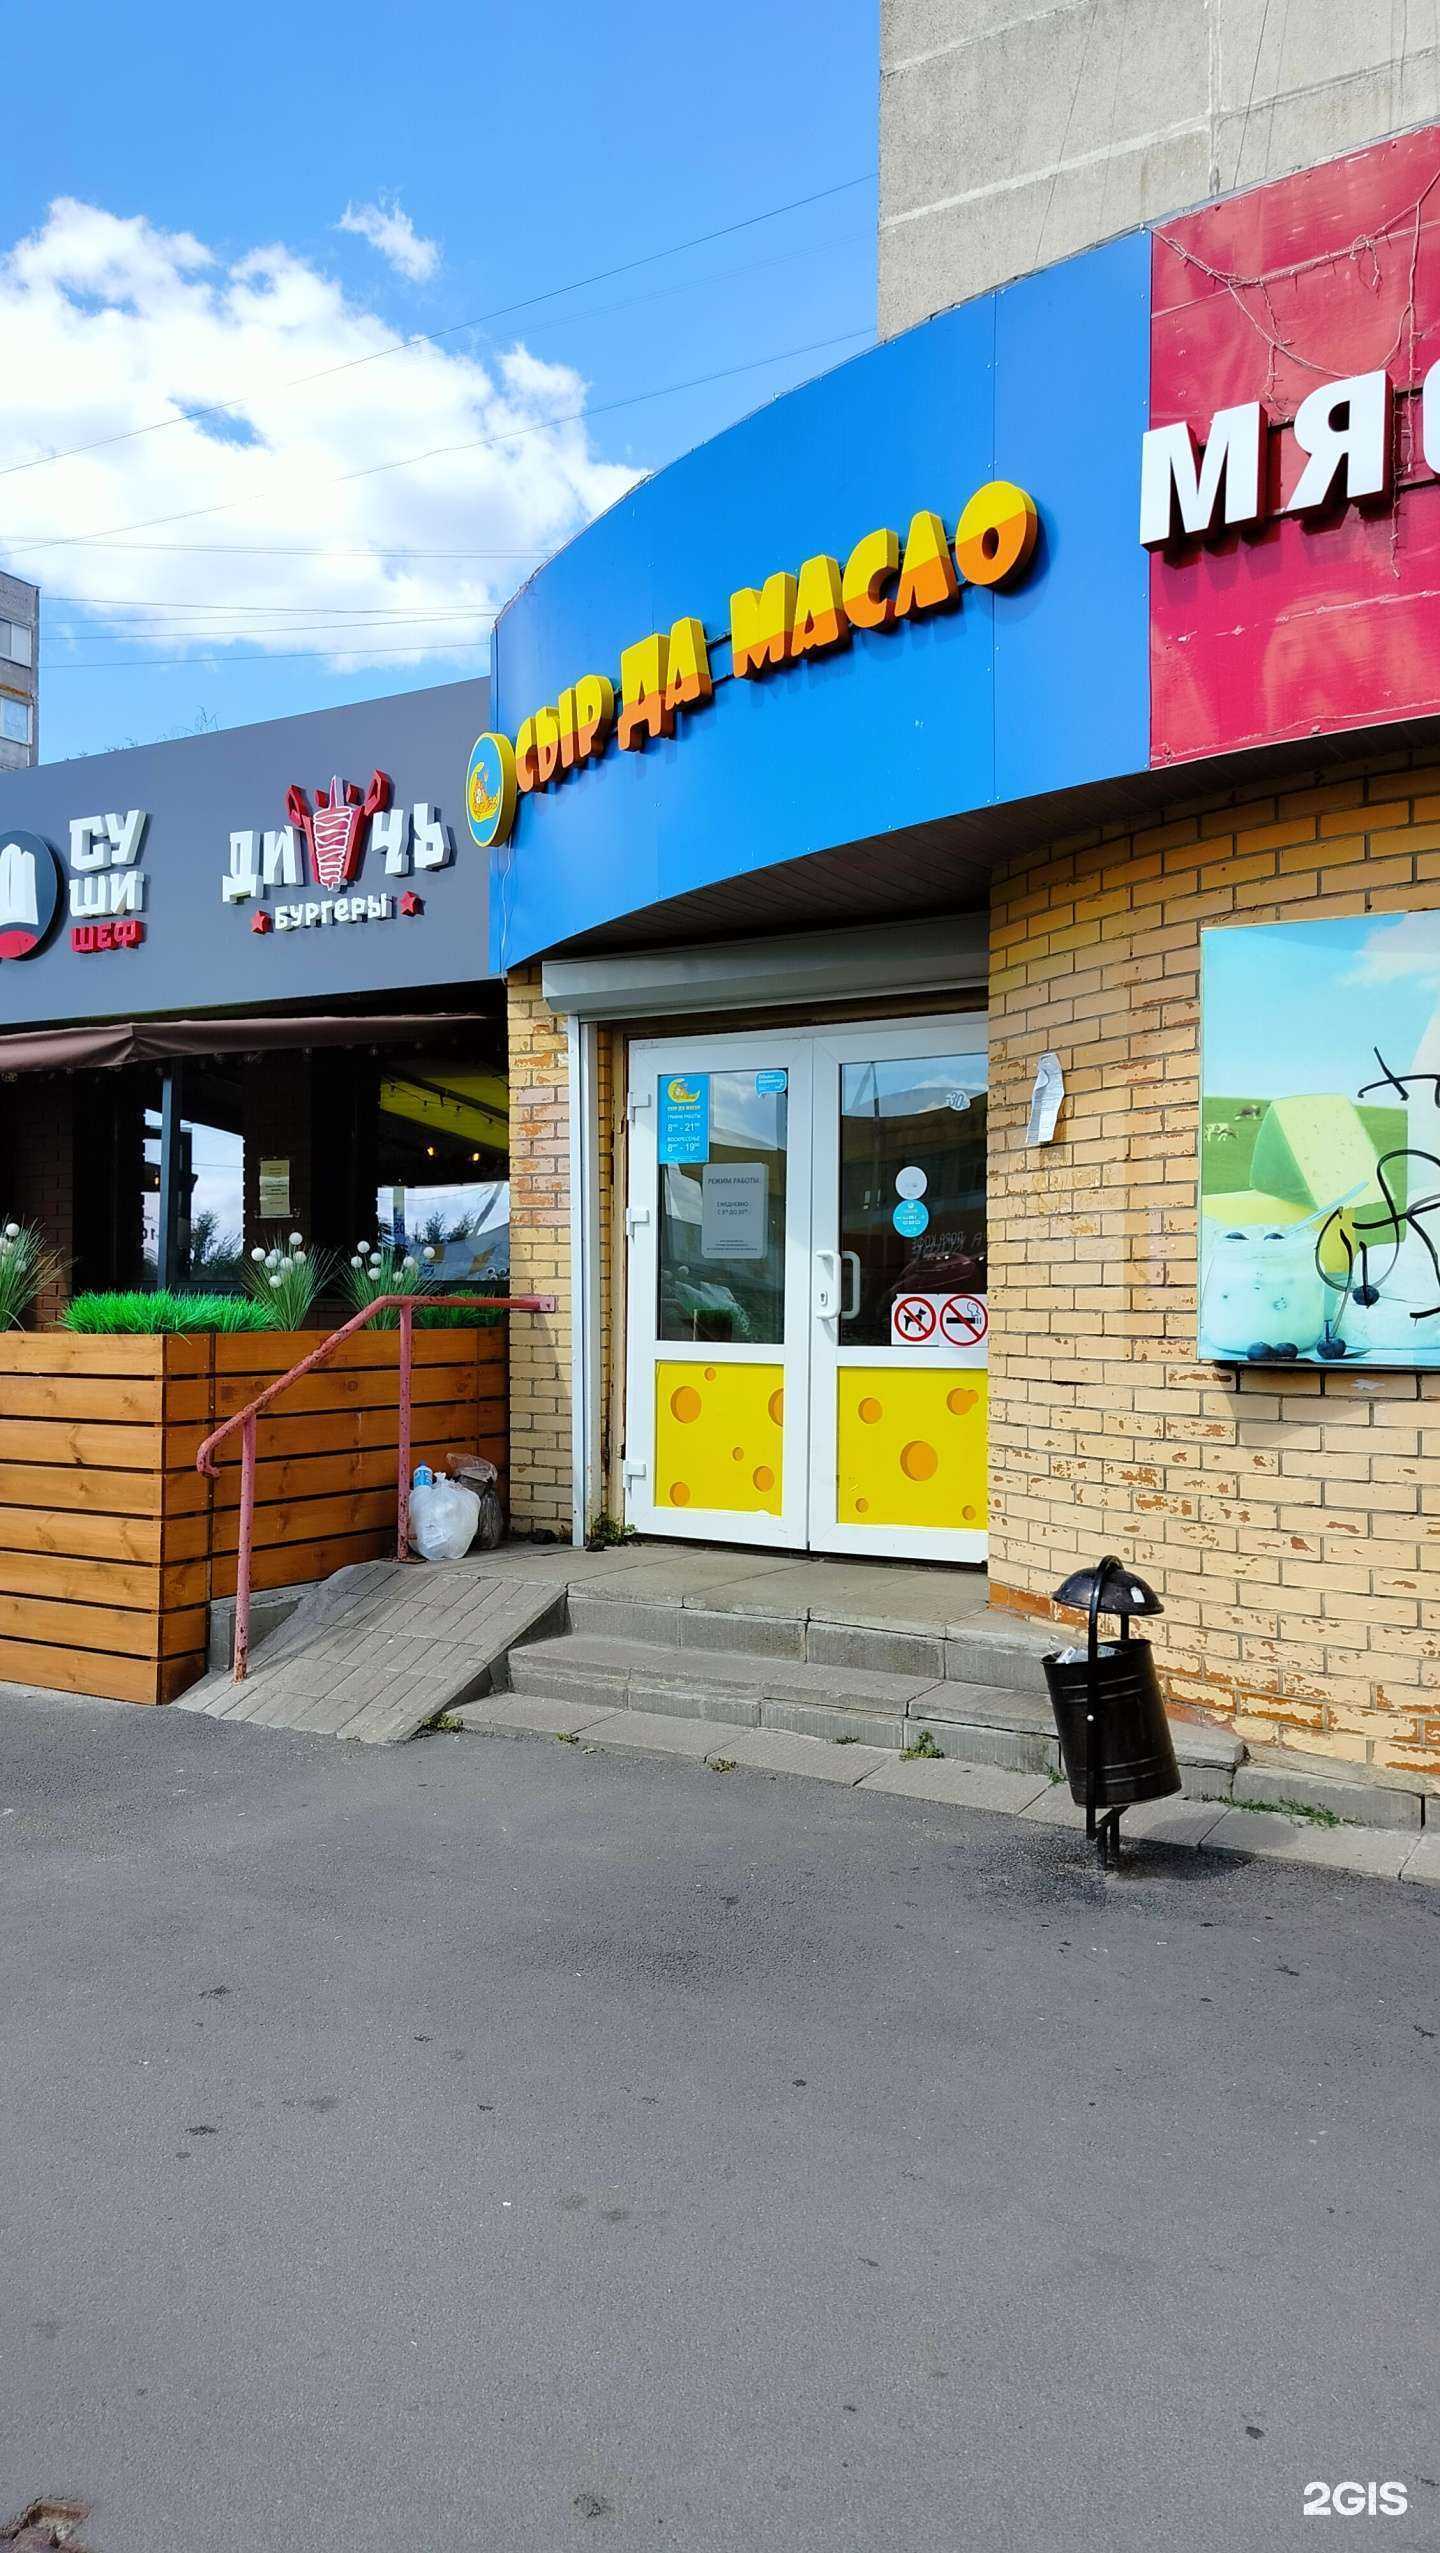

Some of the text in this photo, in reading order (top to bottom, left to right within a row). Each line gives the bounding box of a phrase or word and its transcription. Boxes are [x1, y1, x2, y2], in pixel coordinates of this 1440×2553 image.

[1140, 360, 1440, 551] МЯ
[515, 480, 1038, 793] СЫР ДА МАСЛО
[69, 809, 147, 873] СУ
[69, 870, 145, 917] ШИ
[71, 919, 146, 953] ШЕФ
